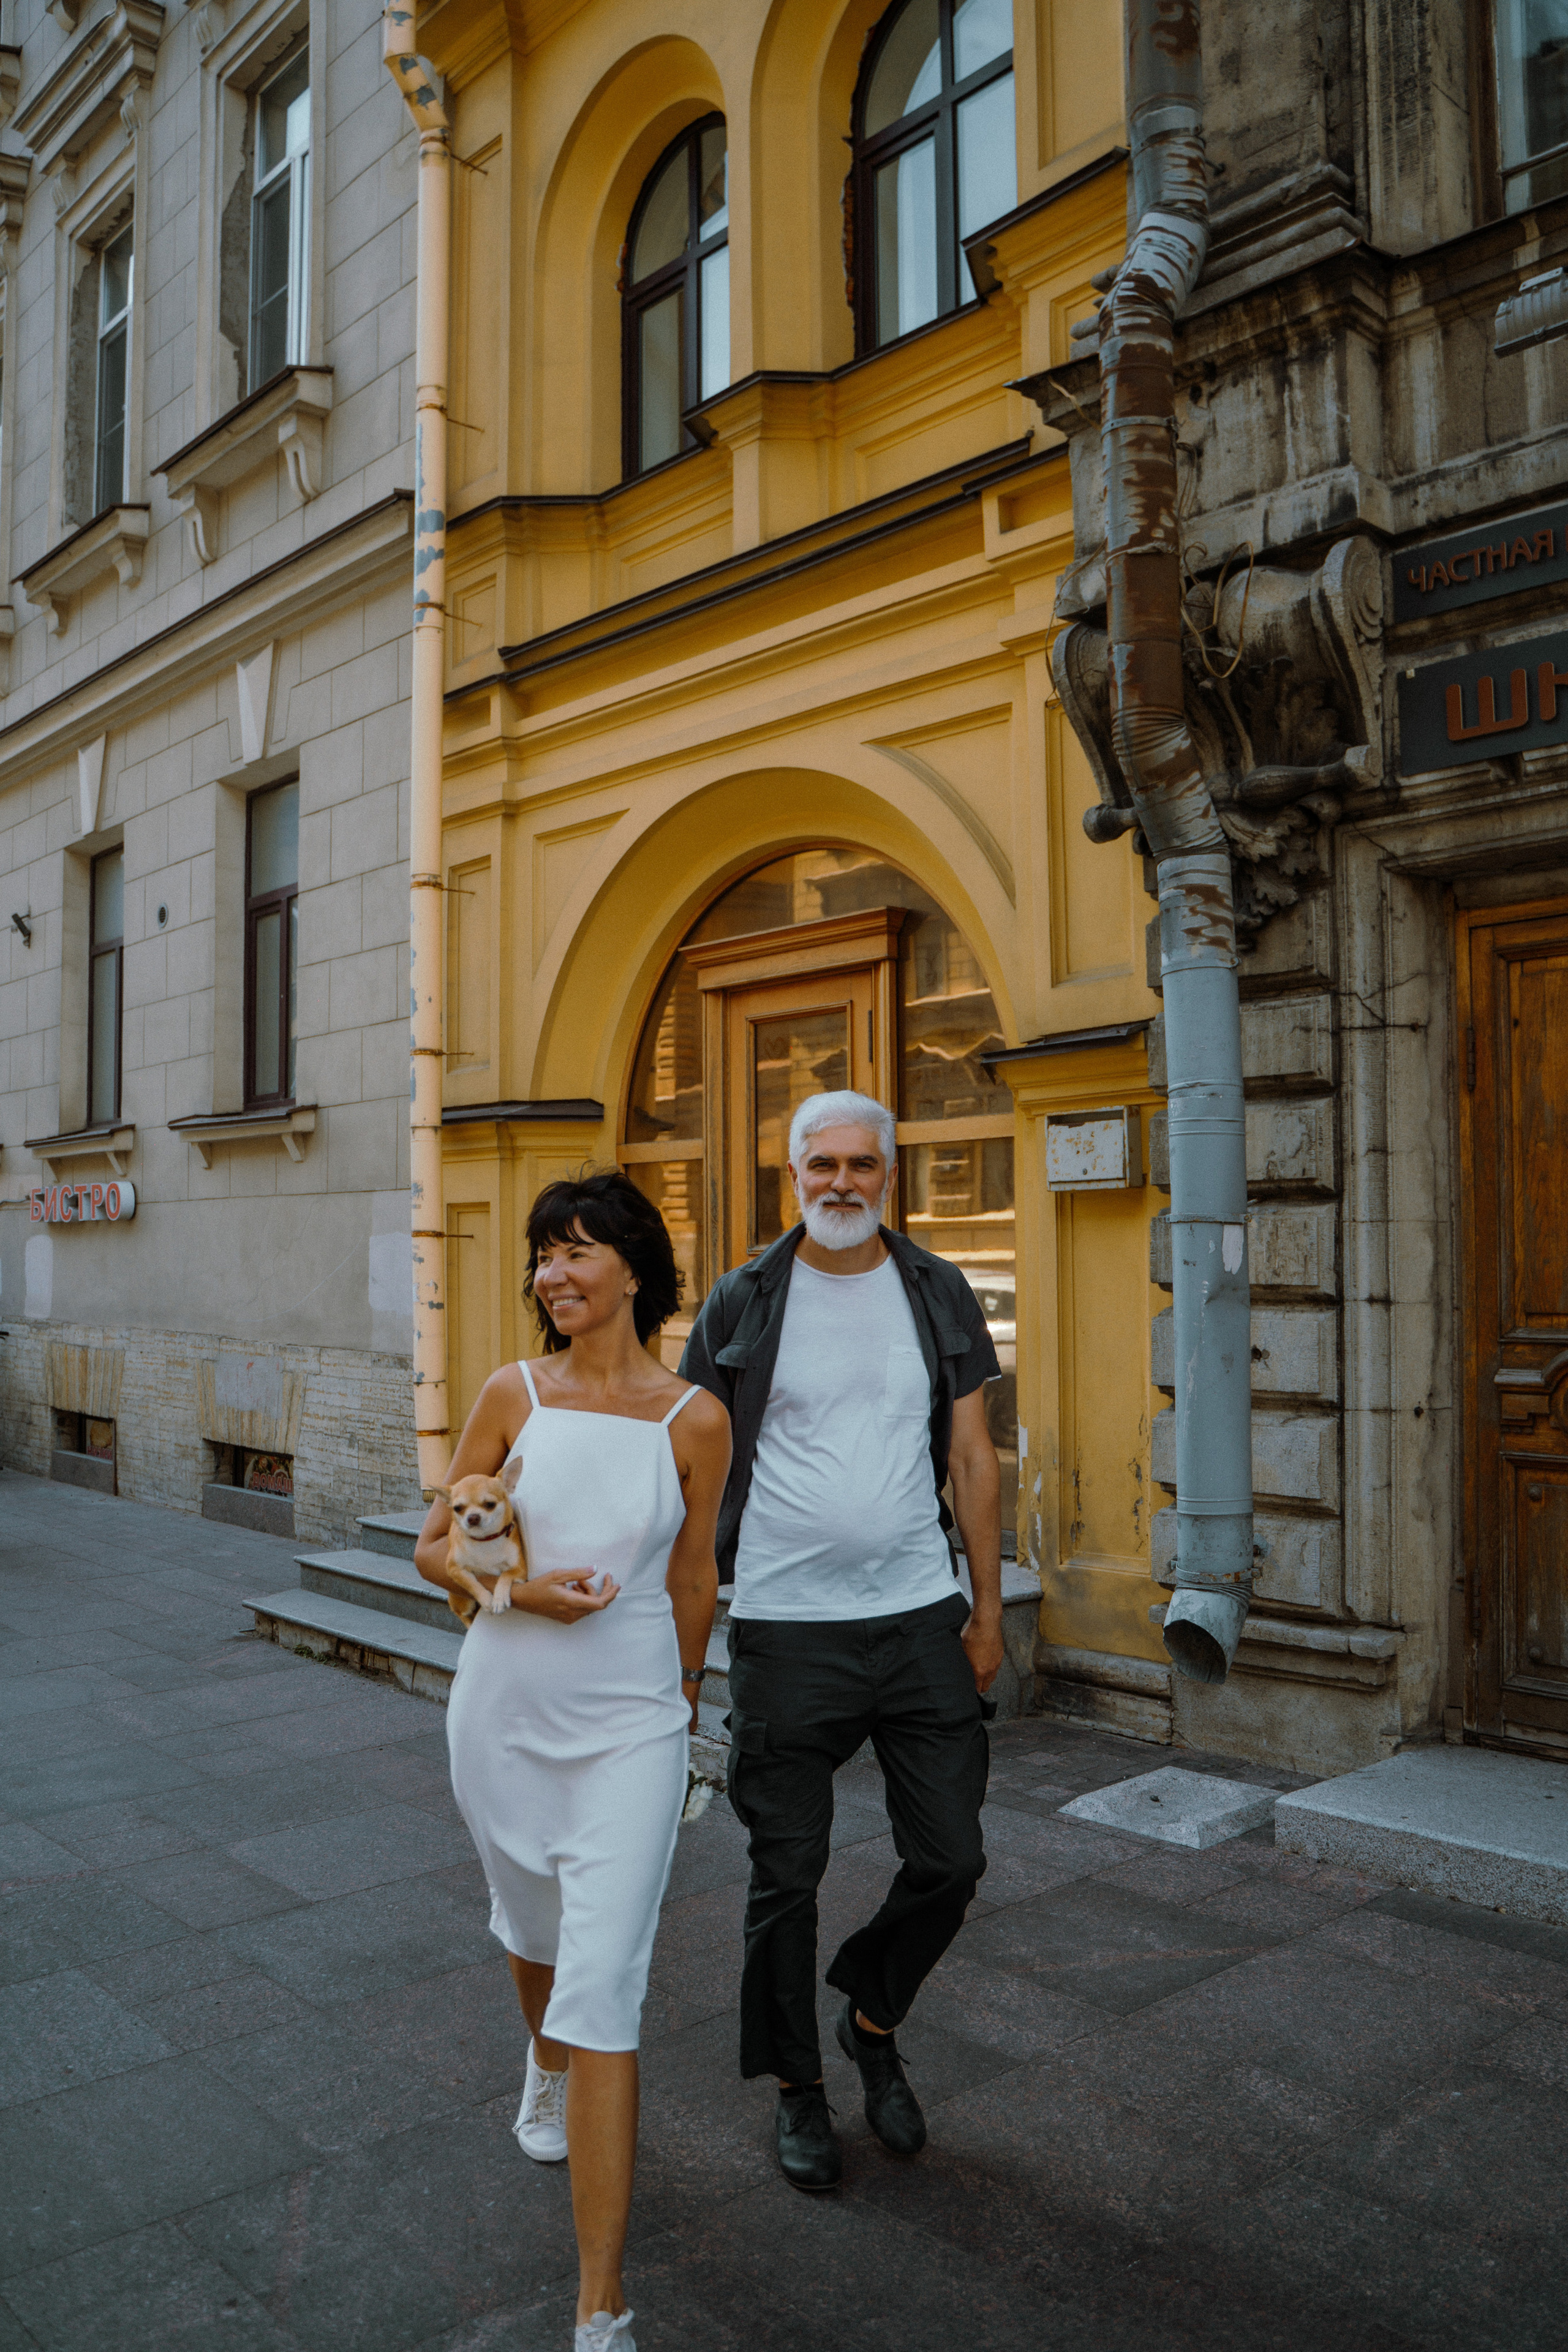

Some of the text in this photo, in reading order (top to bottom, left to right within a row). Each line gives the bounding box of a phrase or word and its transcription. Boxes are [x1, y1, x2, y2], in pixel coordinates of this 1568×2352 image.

[1408, 529, 1554, 592] ЧАСТНАЯ
[31, 1182, 121, 1221] БИСТРО
[252, 1472, 293, 1493] ДОМАШ
